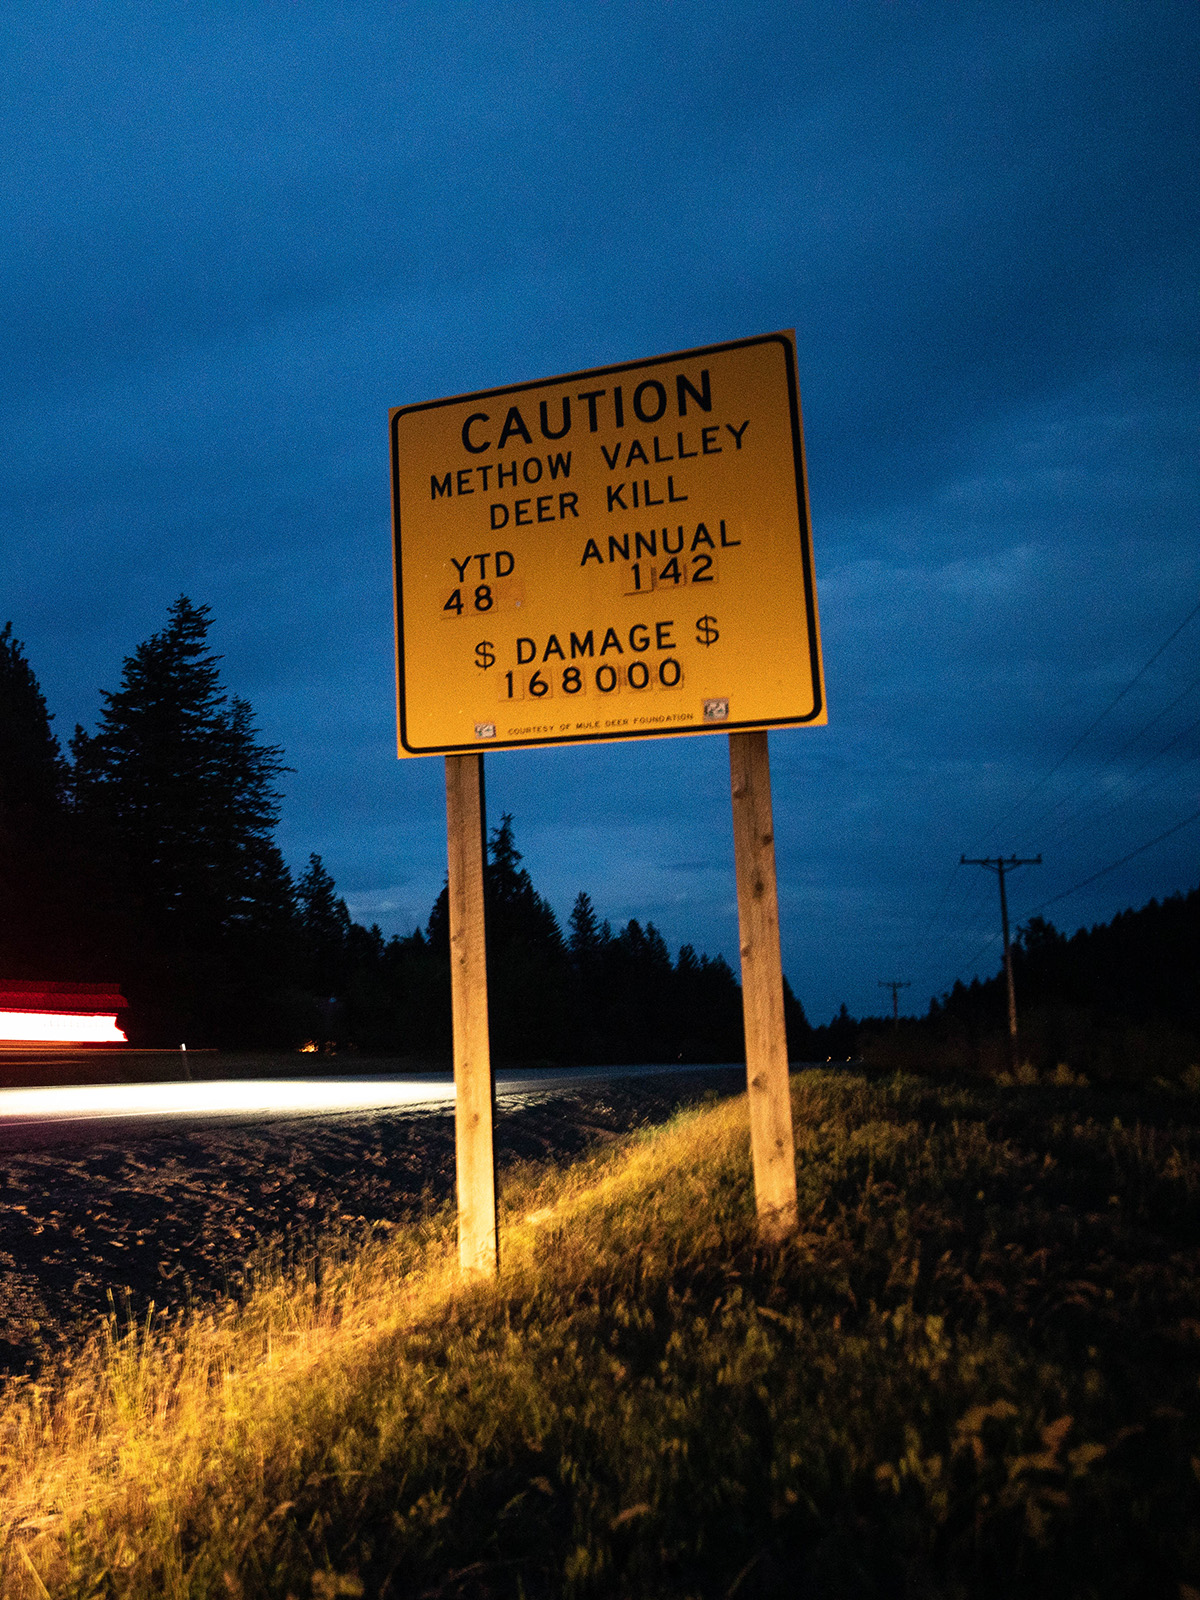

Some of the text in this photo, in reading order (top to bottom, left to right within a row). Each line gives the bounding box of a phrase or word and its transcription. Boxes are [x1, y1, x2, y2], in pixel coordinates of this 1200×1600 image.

[461, 370, 713, 454] CAUTION
[430, 420, 750, 500] METHOW VALLEY
[490, 476, 688, 530] DEER KILL
[580, 519, 742, 566] ANNUAL
[451, 550, 515, 582] YTD
[631, 554, 714, 591] 142
[443, 585, 494, 615] 48
[474, 615, 720, 671] $ DAMAGE $
[505, 658, 682, 698] 168000
[508, 712, 694, 735] COURTESY OF MULE DEER FOUNDATION
